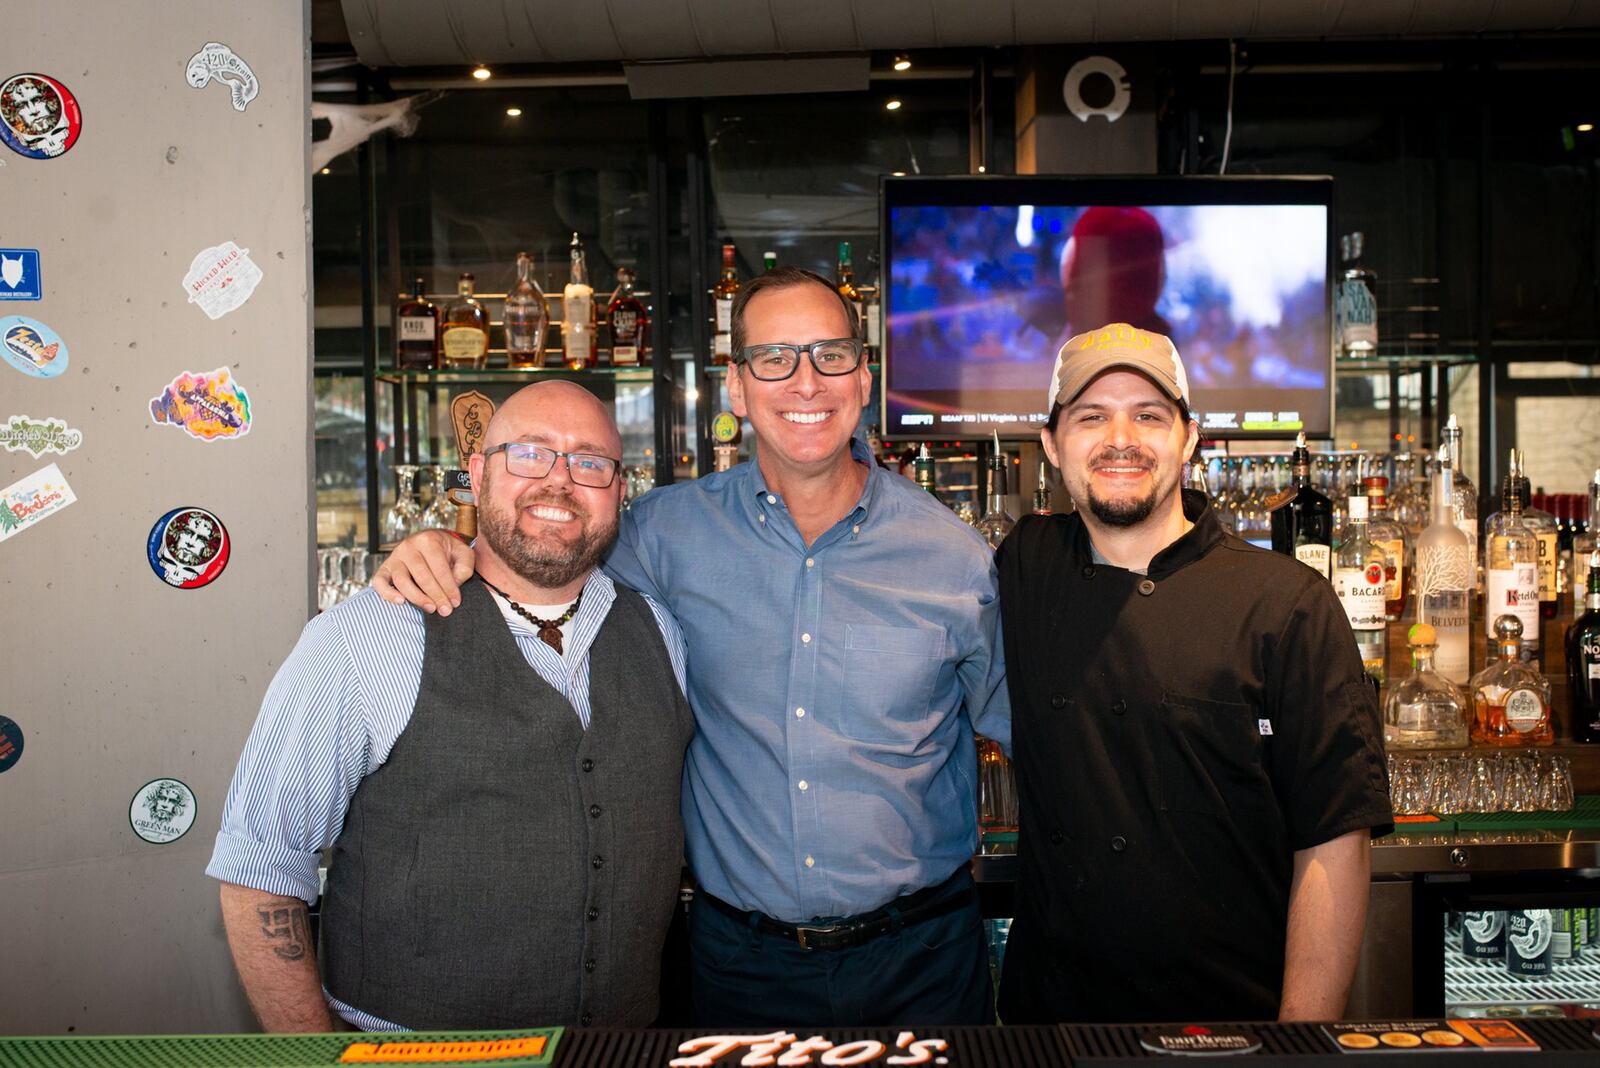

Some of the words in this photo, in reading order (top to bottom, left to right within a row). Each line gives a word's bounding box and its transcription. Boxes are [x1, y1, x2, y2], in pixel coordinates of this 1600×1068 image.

[1299, 550, 1326, 560] SLANE
[1351, 587, 1385, 597] BACAR
[1431, 615, 1466, 627] BELVED
[134, 819, 161, 831] GREEN
[164, 825, 182, 834] MAN
